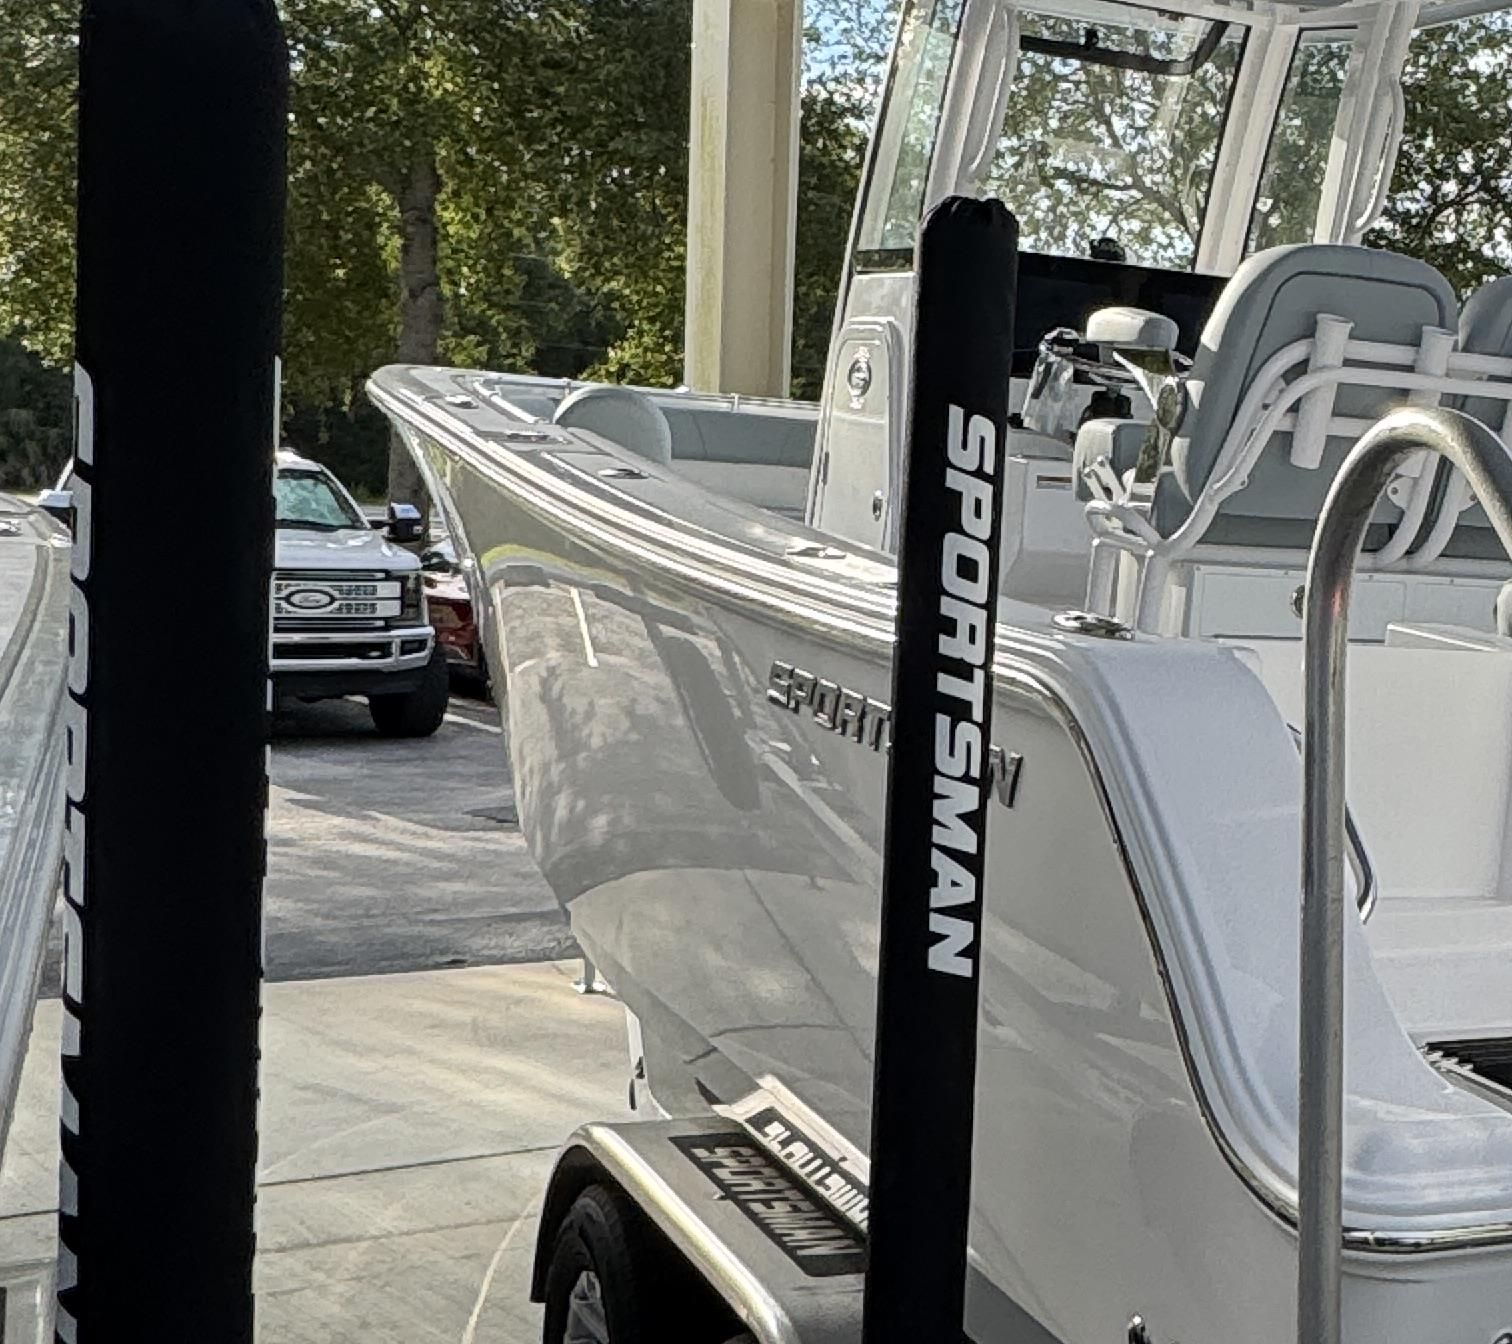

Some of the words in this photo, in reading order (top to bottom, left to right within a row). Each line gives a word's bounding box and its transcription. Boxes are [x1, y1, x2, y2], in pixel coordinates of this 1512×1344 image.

[766, 659, 1024, 809] SPORTN
[926, 404, 997, 978] SPORTSMAN
[690, 1144, 866, 1256] SPORTSMAN
